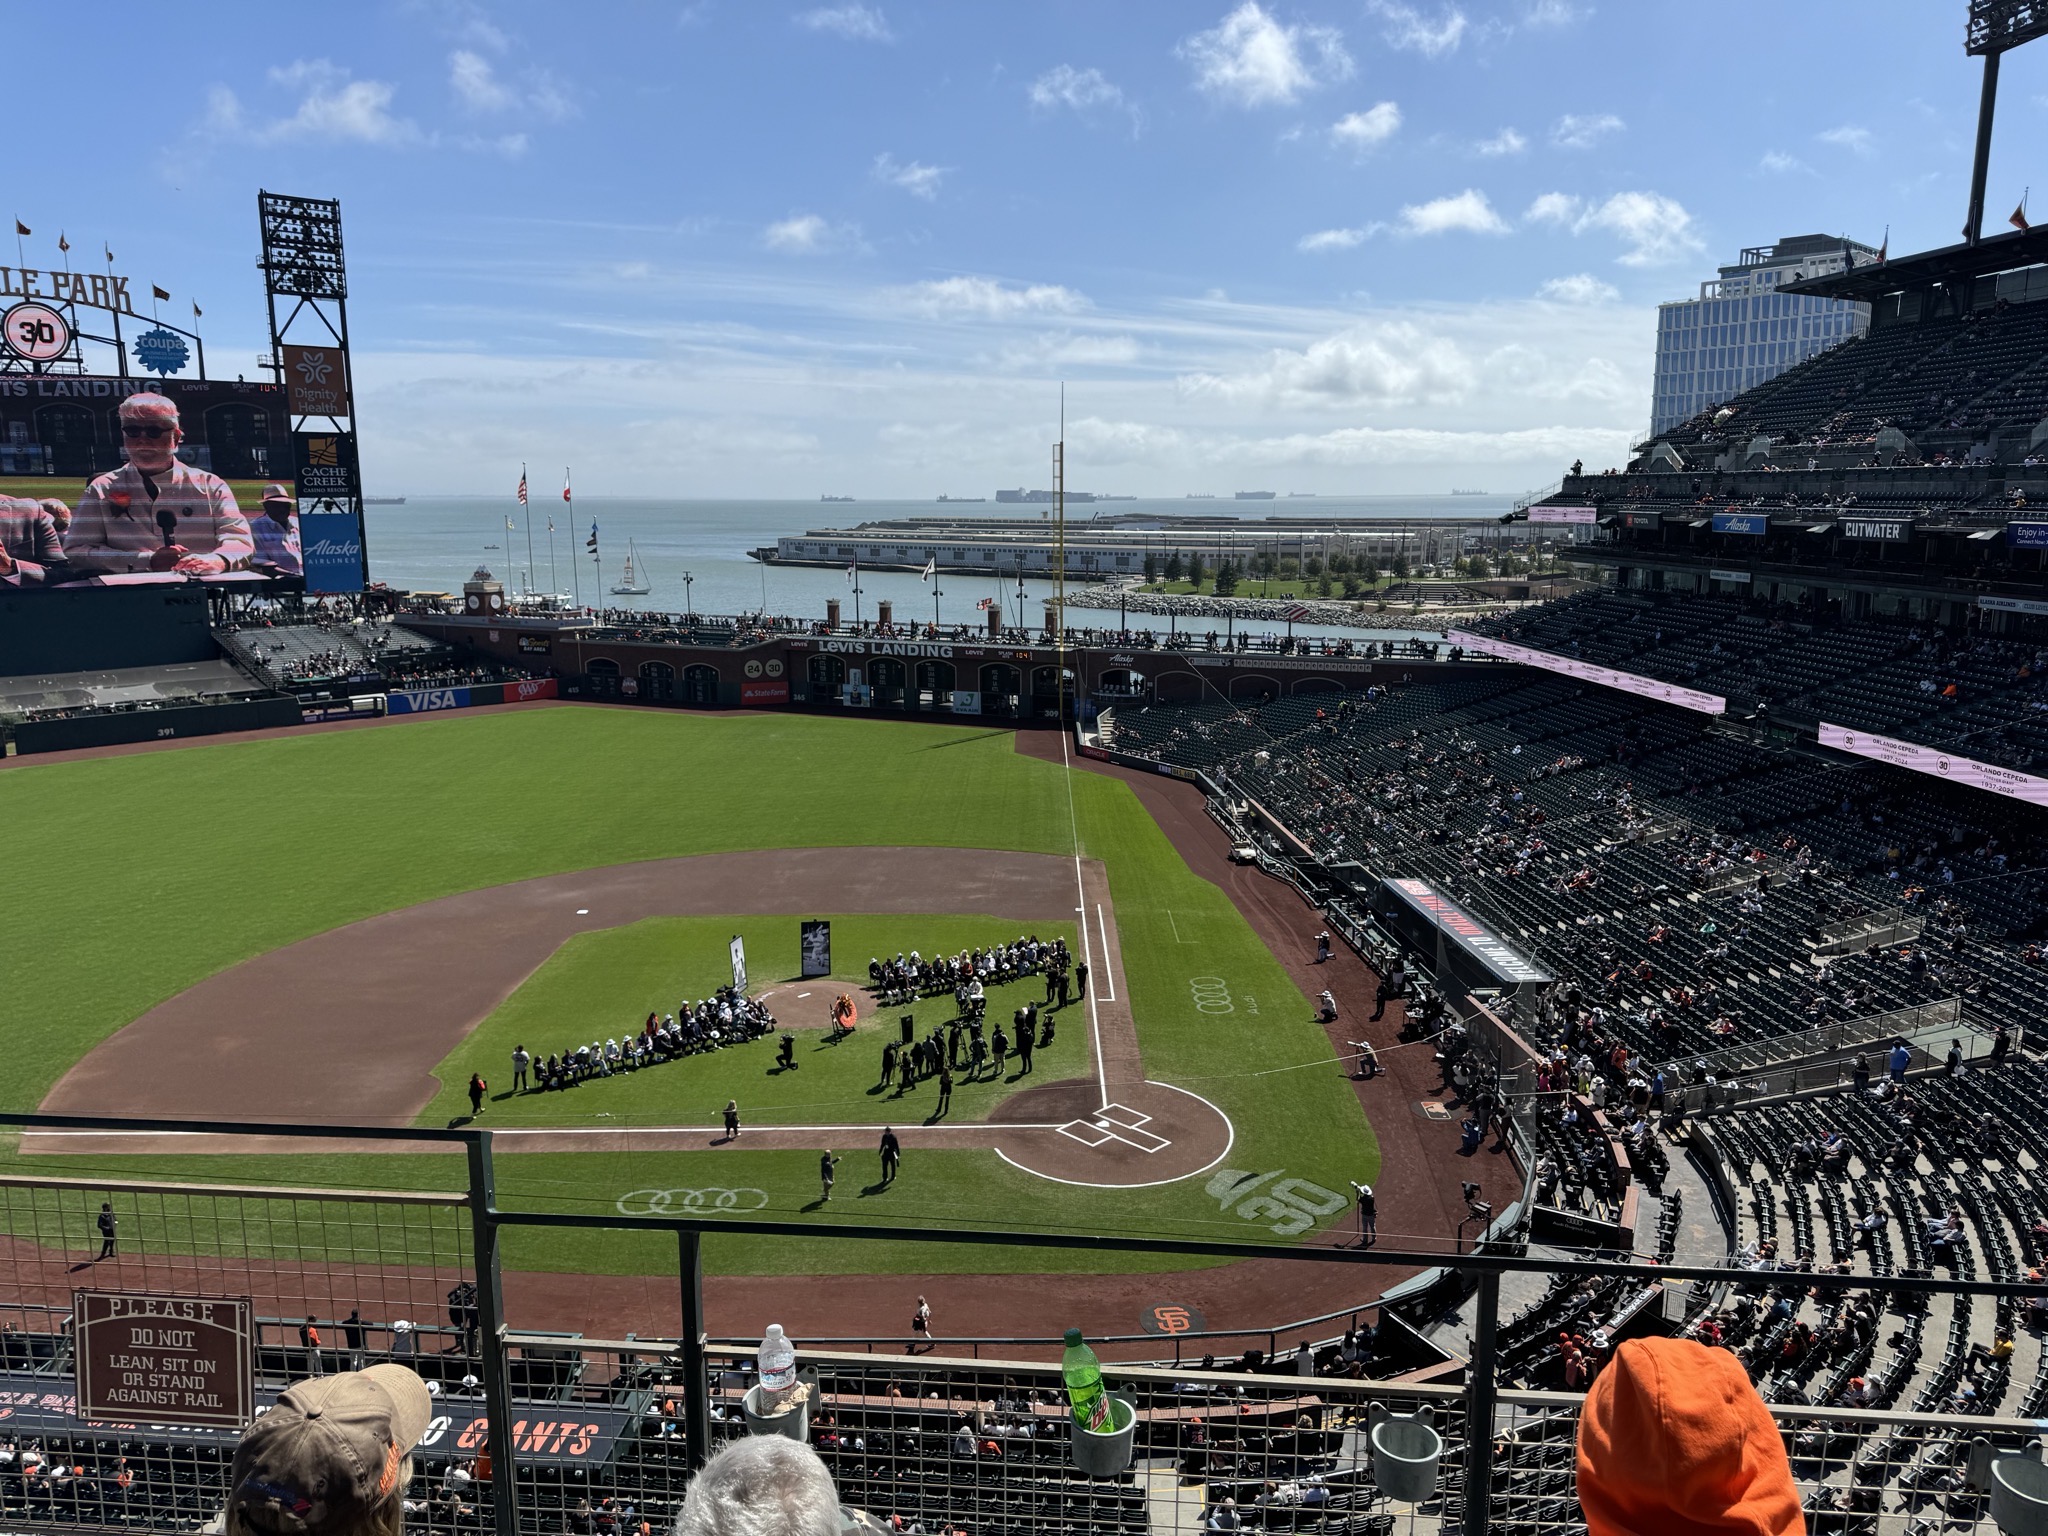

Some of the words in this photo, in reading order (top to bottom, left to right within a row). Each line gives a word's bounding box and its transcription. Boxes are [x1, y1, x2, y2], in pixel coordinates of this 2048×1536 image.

[51, 271, 135, 315] PARK
[19, 321, 54, 345] 30
[140, 337, 184, 351] coupa
[38, 380, 162, 397] LANDING
[295, 387, 338, 403] Dignity
[298, 402, 338, 414] Health
[301, 467, 348, 477] CACHE
[303, 477, 348, 487] CREEK
[1633, 517, 1649, 525] TOYOTA
[1724, 517, 1750, 532] Alaska
[1845, 522, 1900, 539] CUTWATER
[2017, 526, 2037, 539] Enjoy
[304, 539, 360, 556] Alaska
[308, 557, 356, 565] AIRLINES
[1151, 607, 1188, 617] BANK
[1192, 608, 1210, 617] OF
[1212, 608, 1277, 619] AMERICA
[871, 643, 953, 658] LANDING
[1108, 653, 1135, 663] Alaska
[747, 665, 760, 673] 24
[768, 664, 781, 672] 30
[519, 682, 537, 695] AAA
[403, 690, 457, 711] VISA
[158, 728, 175, 736] 391
[1845, 736, 1853, 745] 30
[1872, 738, 1898, 749] ORLANDO
[1897, 745, 1919, 755] CEPEDA
[1085, 749, 1105, 758] ORACLE
[1880, 754, 1908, 765] 1937-2024
[1939, 761, 1948, 770] 30
[1971, 764, 2002, 777] ORLANDO
[2002, 772, 2028, 784] CEPEDA
[1981, 781, 2015, 795] 1937-2024
[1415, 896, 1453, 913] PARK
[1437, 911, 1484, 935] ORACLE
[1467, 936, 1498, 947] TO
[1479, 946, 1543, 981] WELCOME
[1237, 1178, 1350, 1235] 30
[109, 1298, 215, 1324] PLEASE
[1610, 1313, 1624, 1326] Audi
[1621, 1298, 1640, 1318] Dugout
[1638, 1289, 1653, 1302] Club
[130, 1327, 153, 1346] DO
[158, 1329, 196, 1348] NOT
[110, 1354, 158, 1373] LEAN,
[162, 1357, 189, 1372] SIT
[193, 1359, 216, 1374] ON
[123, 1372, 144, 1386] OR
[149, 1374, 205, 1390] STAND
[106, 1388, 179, 1405] AGAINST
[184, 1393, 223, 1408] RAIL
[456, 1418, 599, 1455] GANTS
[1192, 1434, 1204, 1443] 28
